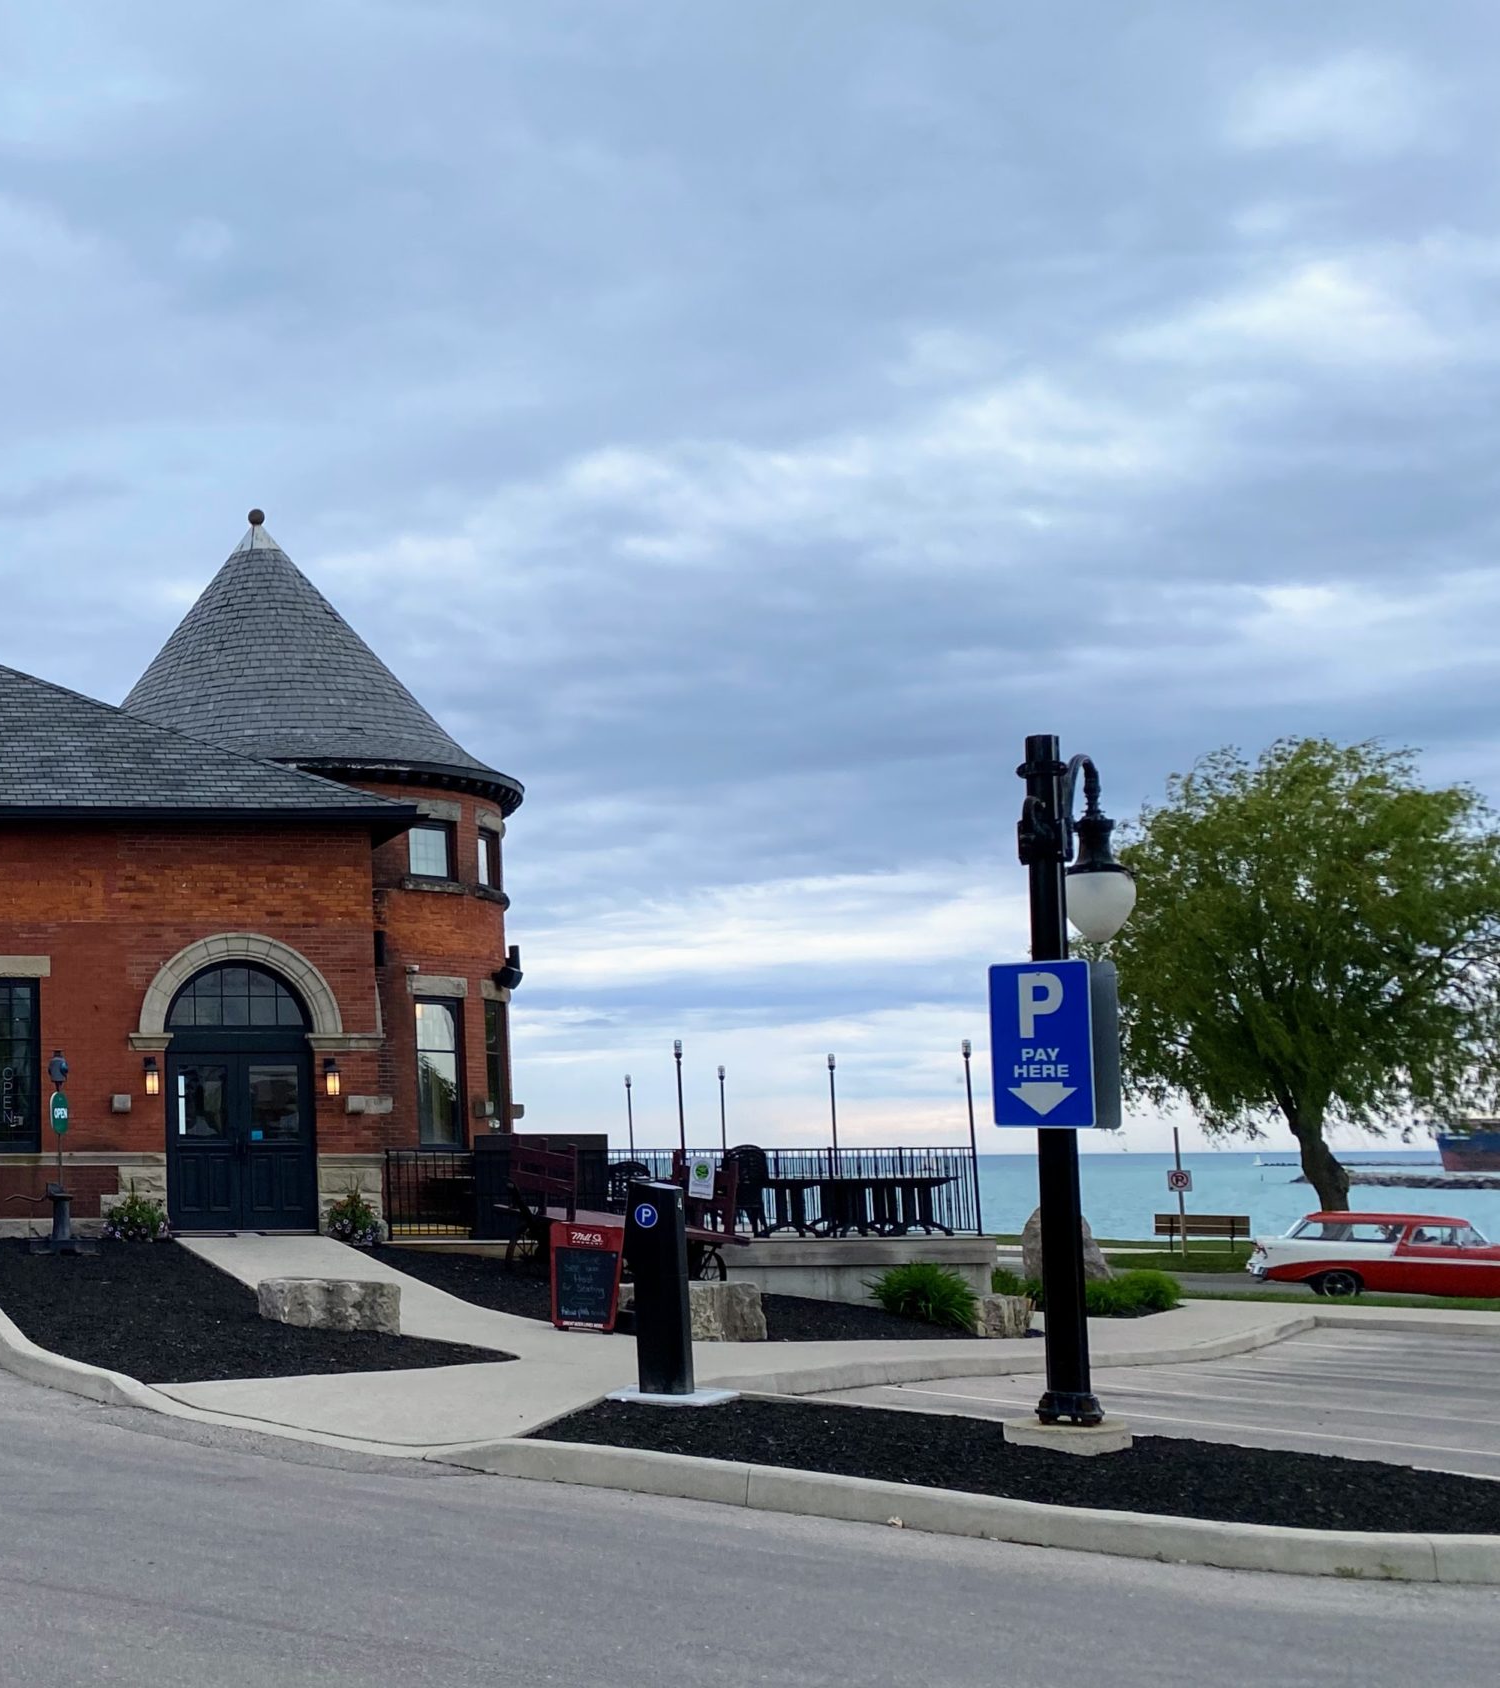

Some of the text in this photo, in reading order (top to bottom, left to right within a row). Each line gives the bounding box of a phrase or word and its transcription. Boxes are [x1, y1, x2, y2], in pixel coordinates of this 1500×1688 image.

[1017, 972, 1064, 1039] P
[1021, 1048, 1060, 1062] PAY
[1013, 1064, 1070, 1078] HERE
[3, 1067, 13, 1123] OPEN
[54, 1108, 68, 1119] OPEN
[677, 1197, 683, 1211] 4
[641, 1208, 652, 1223] P
[571, 1231, 592, 1241] Mill
